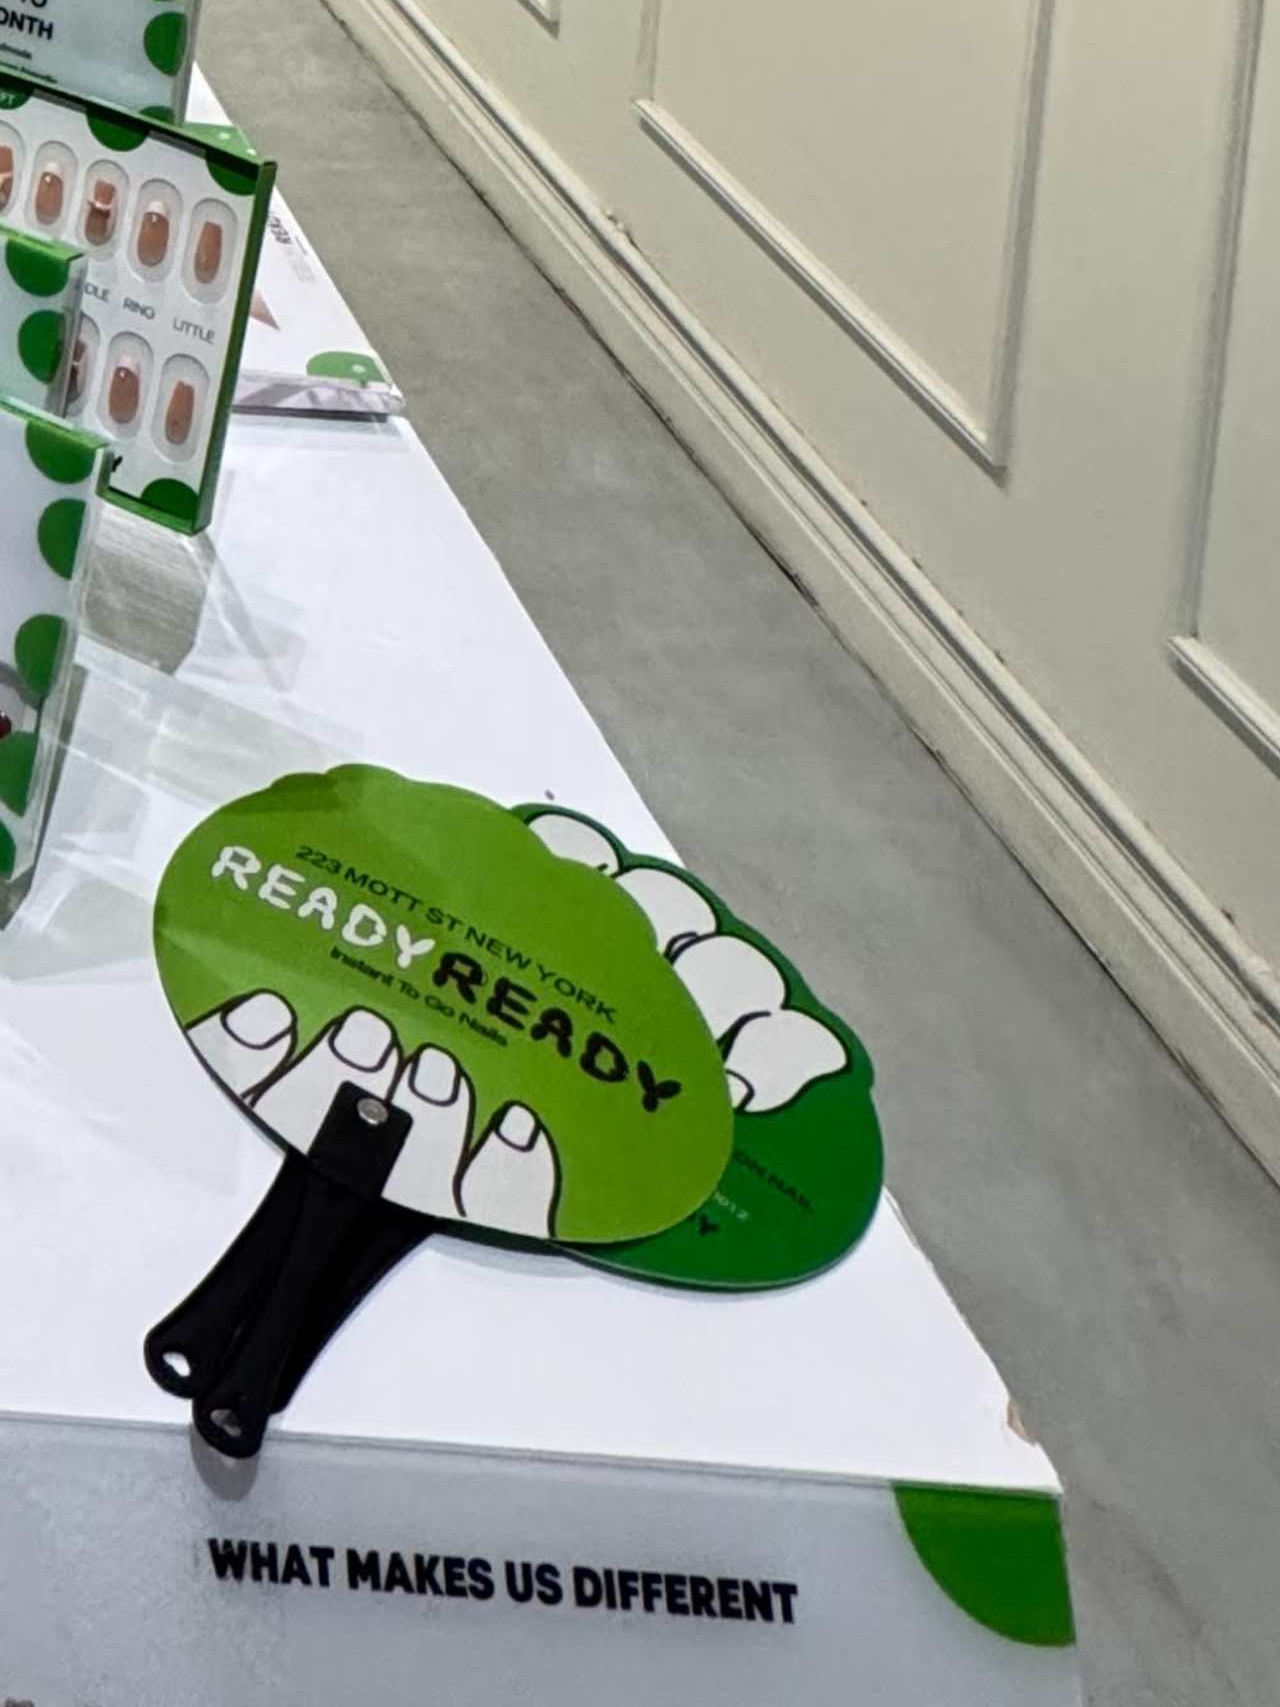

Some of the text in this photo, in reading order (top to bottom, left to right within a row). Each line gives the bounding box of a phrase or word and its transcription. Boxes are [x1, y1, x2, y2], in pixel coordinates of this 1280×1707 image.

[172, 315, 216, 345] LITTLE
[211, 844, 684, 1114] READY READY
[295, 844, 618, 1024] 223 MOTT ST NEW YORK
[329, 945, 510, 1048] Instant To Go Nails
[205, 1536, 799, 1626] WHAT MAKES US DIFFERENT
